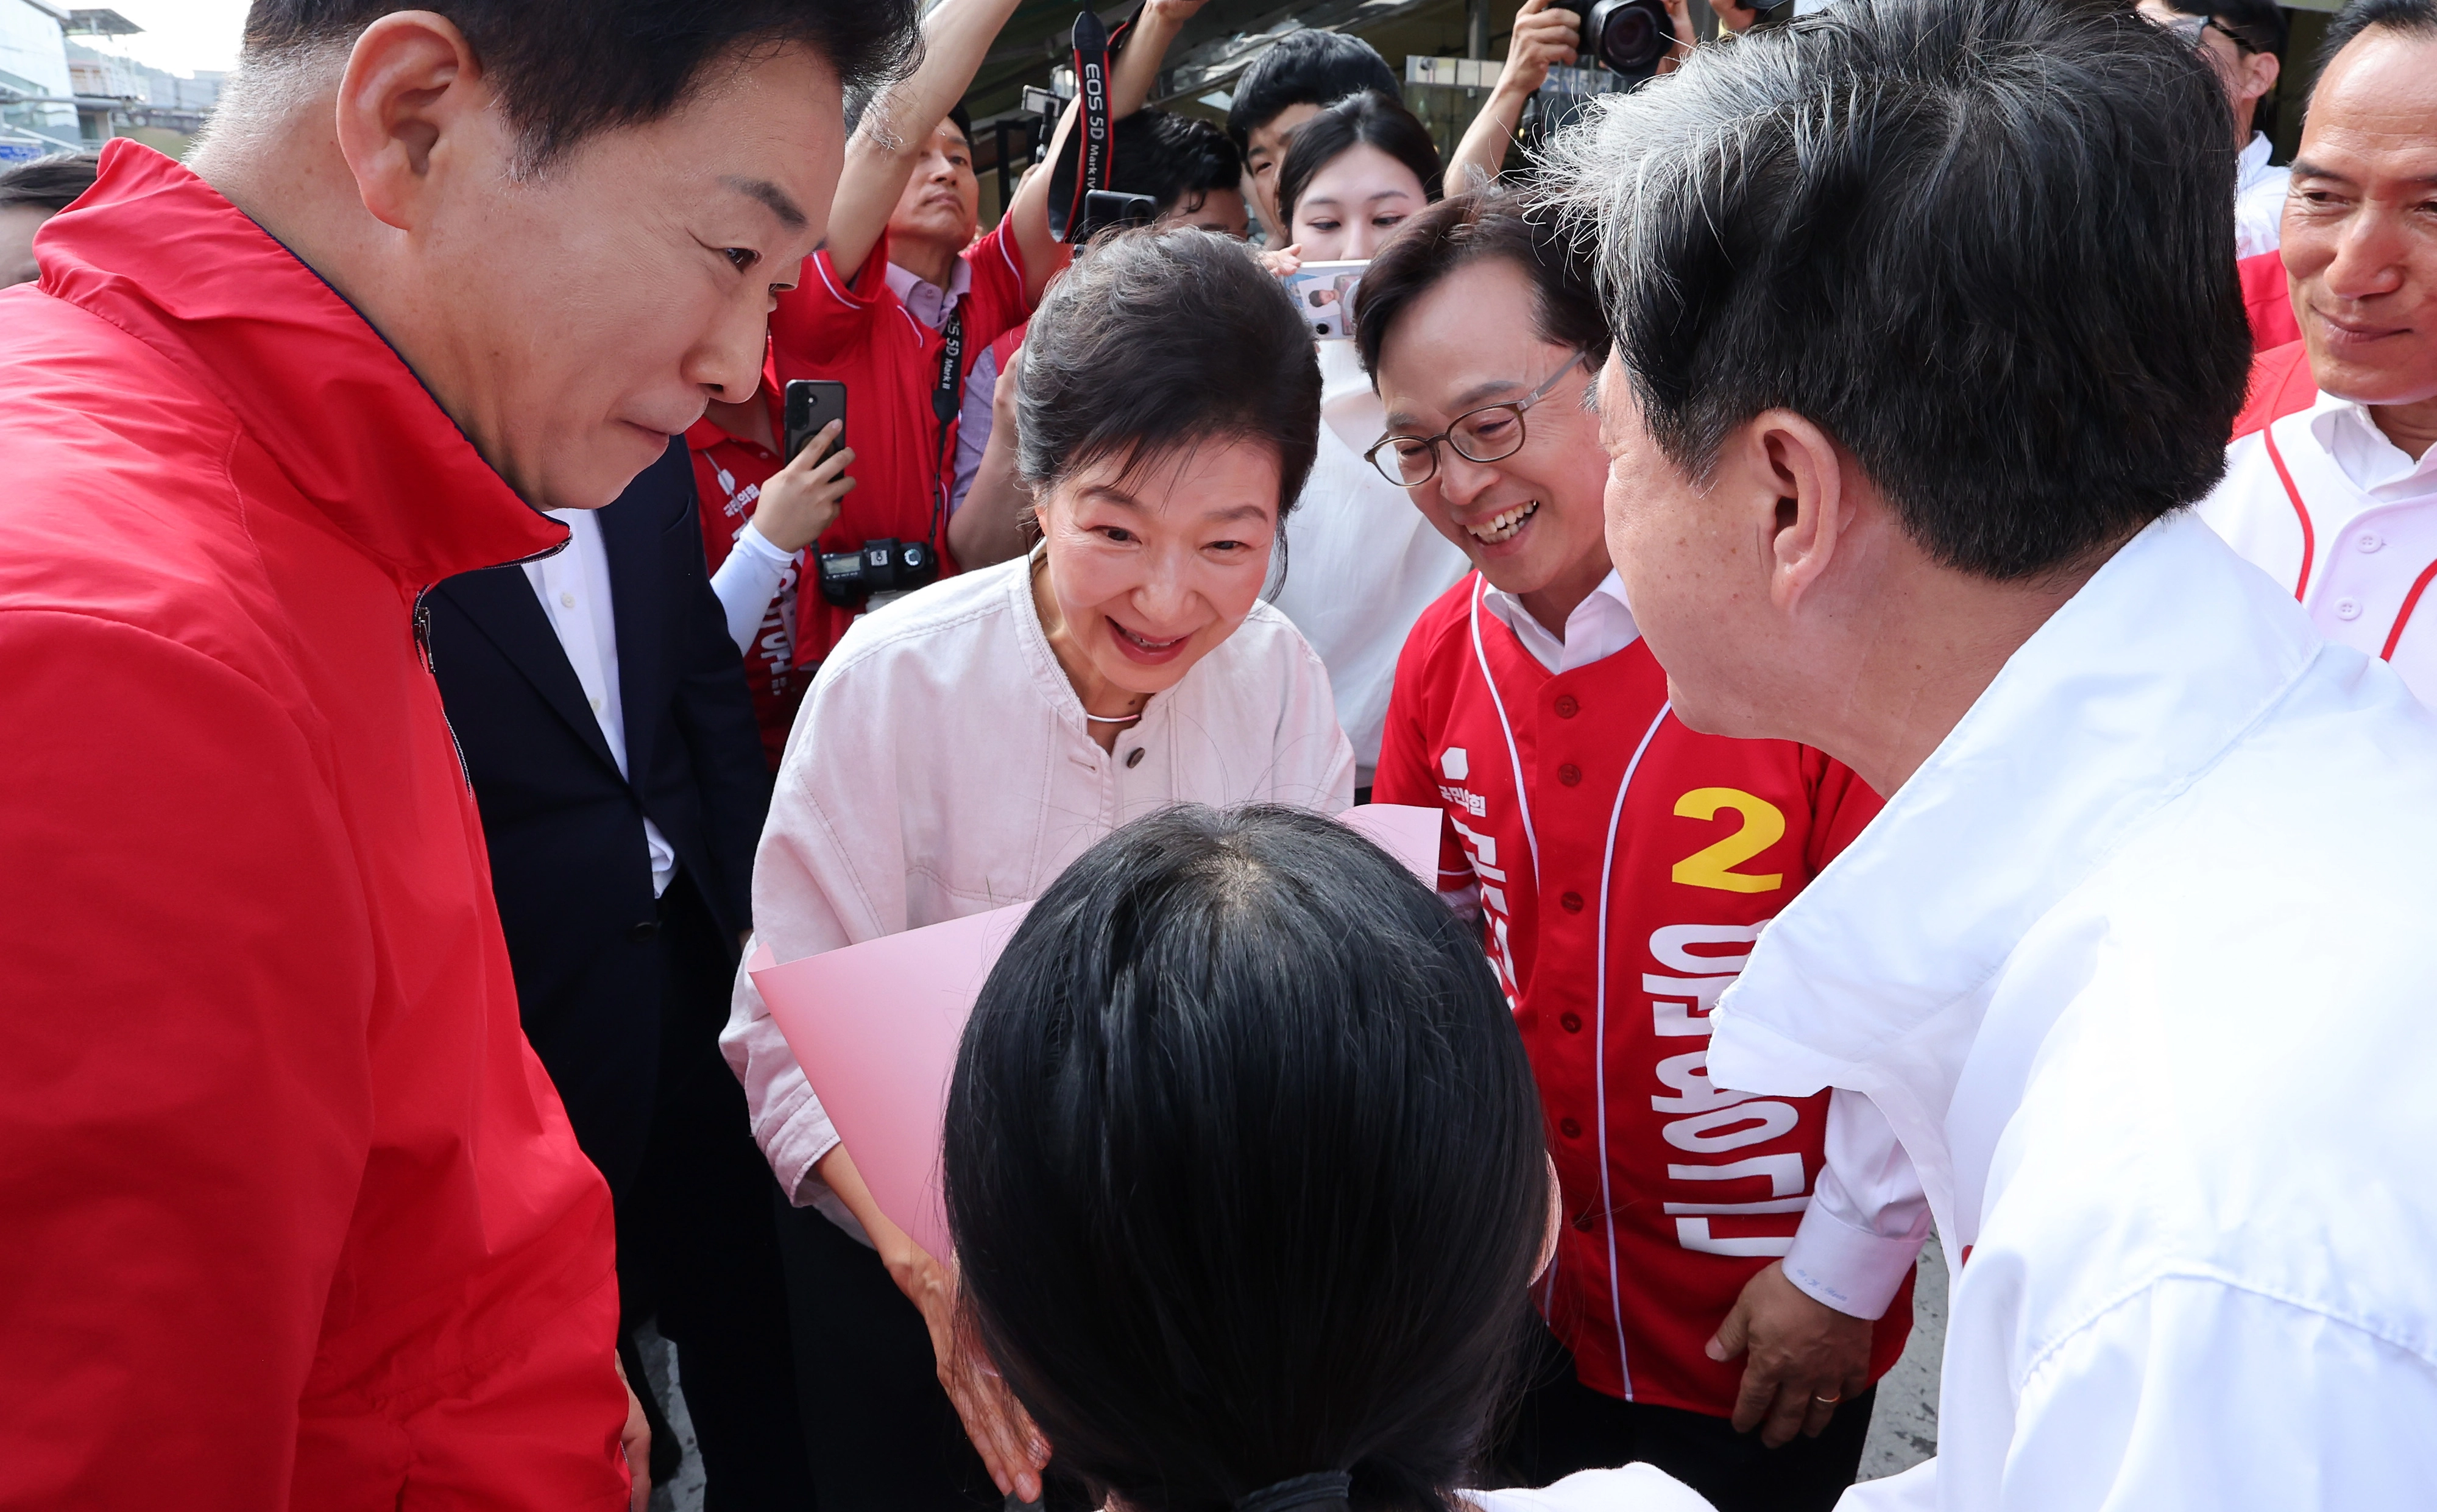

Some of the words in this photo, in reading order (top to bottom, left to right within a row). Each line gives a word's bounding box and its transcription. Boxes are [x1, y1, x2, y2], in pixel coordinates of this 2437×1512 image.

[1085, 63, 1103, 111] EOS
[1089, 115, 1104, 140] 5D
[1088, 144, 1099, 175] Mark
[1087, 177, 1096, 189] IV
[947, 314, 960, 336] OS
[946, 337, 960, 356] 5D
[943, 358, 954, 382] Mark
[1672, 786, 1786, 894] 2
